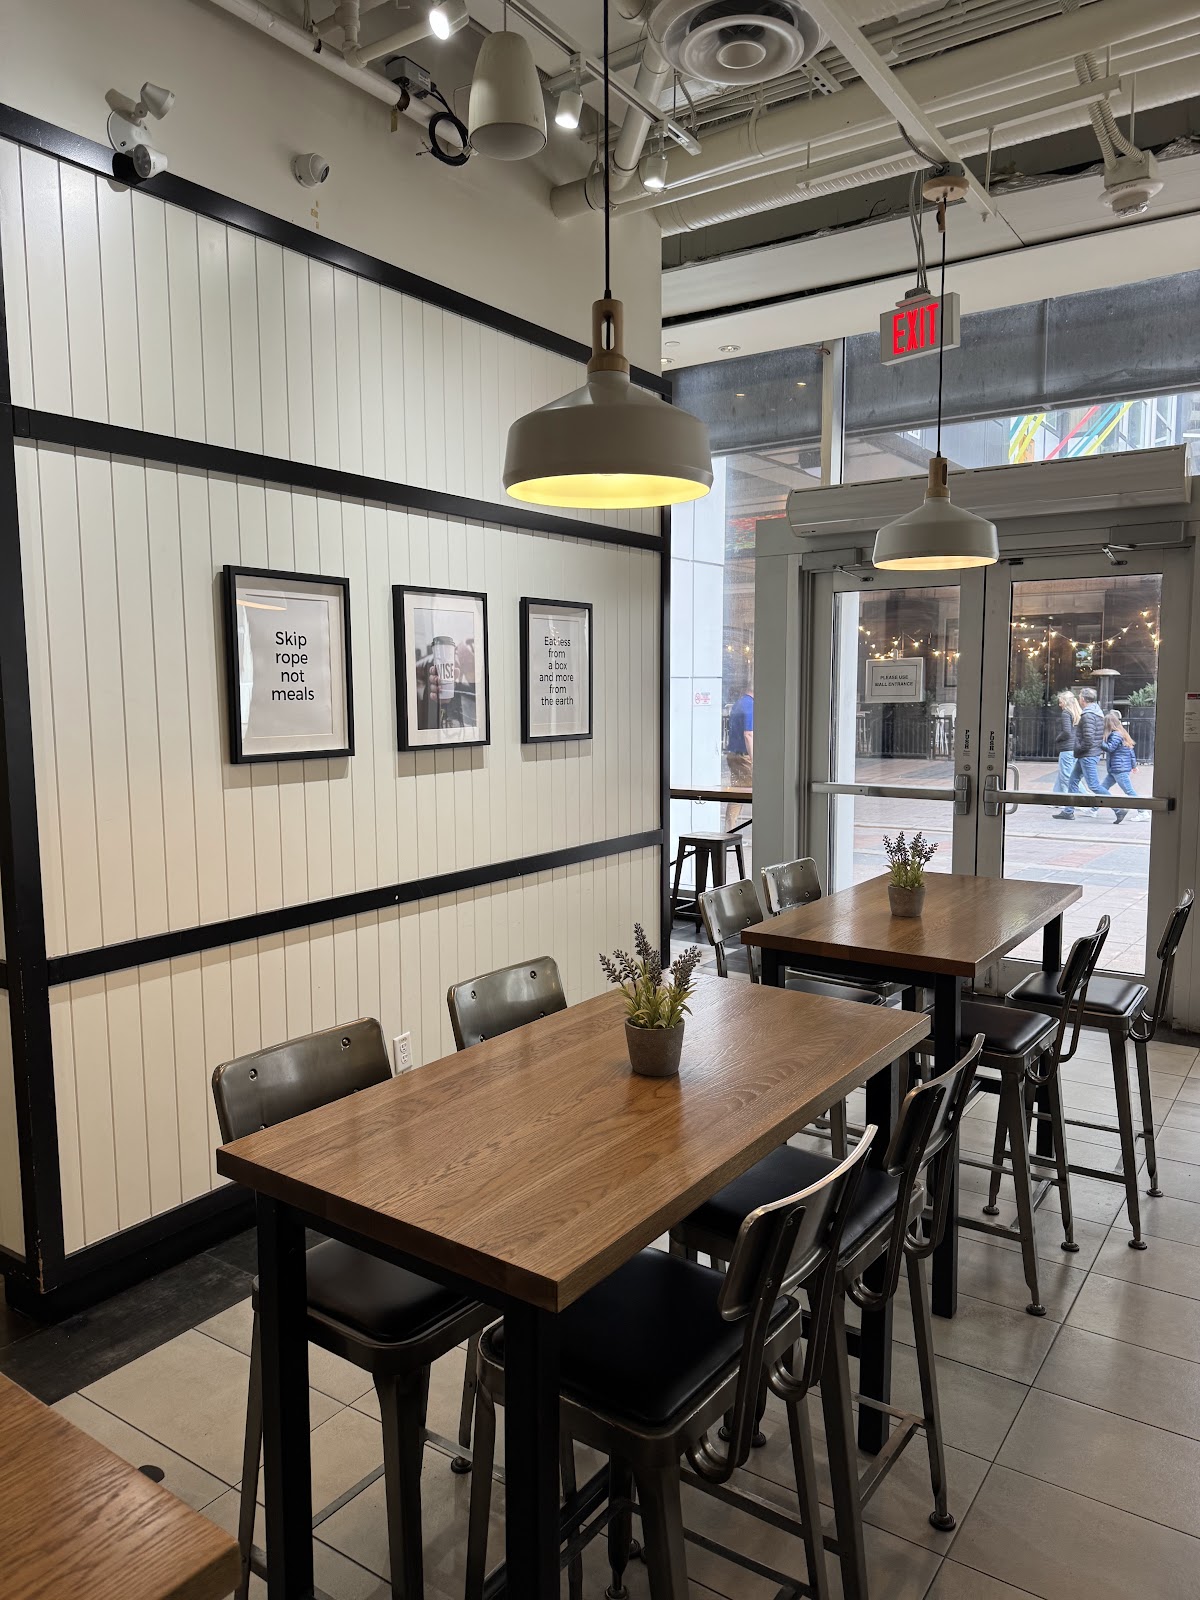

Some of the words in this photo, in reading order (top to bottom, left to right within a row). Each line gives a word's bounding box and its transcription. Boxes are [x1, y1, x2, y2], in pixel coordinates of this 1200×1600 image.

[892, 302, 939, 355] EXIT
[275, 631, 307, 649] Skip
[544, 636, 556, 647] Eat
[557, 637, 571, 647] less
[548, 648, 566, 658] from
[275, 652, 308, 667] rope
[548, 662, 553, 670] a
[555, 660, 567, 670] box
[281, 669, 305, 683] not
[539, 672, 554, 682] and
[555, 674, 574, 682] more
[271, 686, 315, 701] meals
[549, 684, 567, 694] from
[541, 696, 554, 706] the
[555, 697, 574, 706] earth
